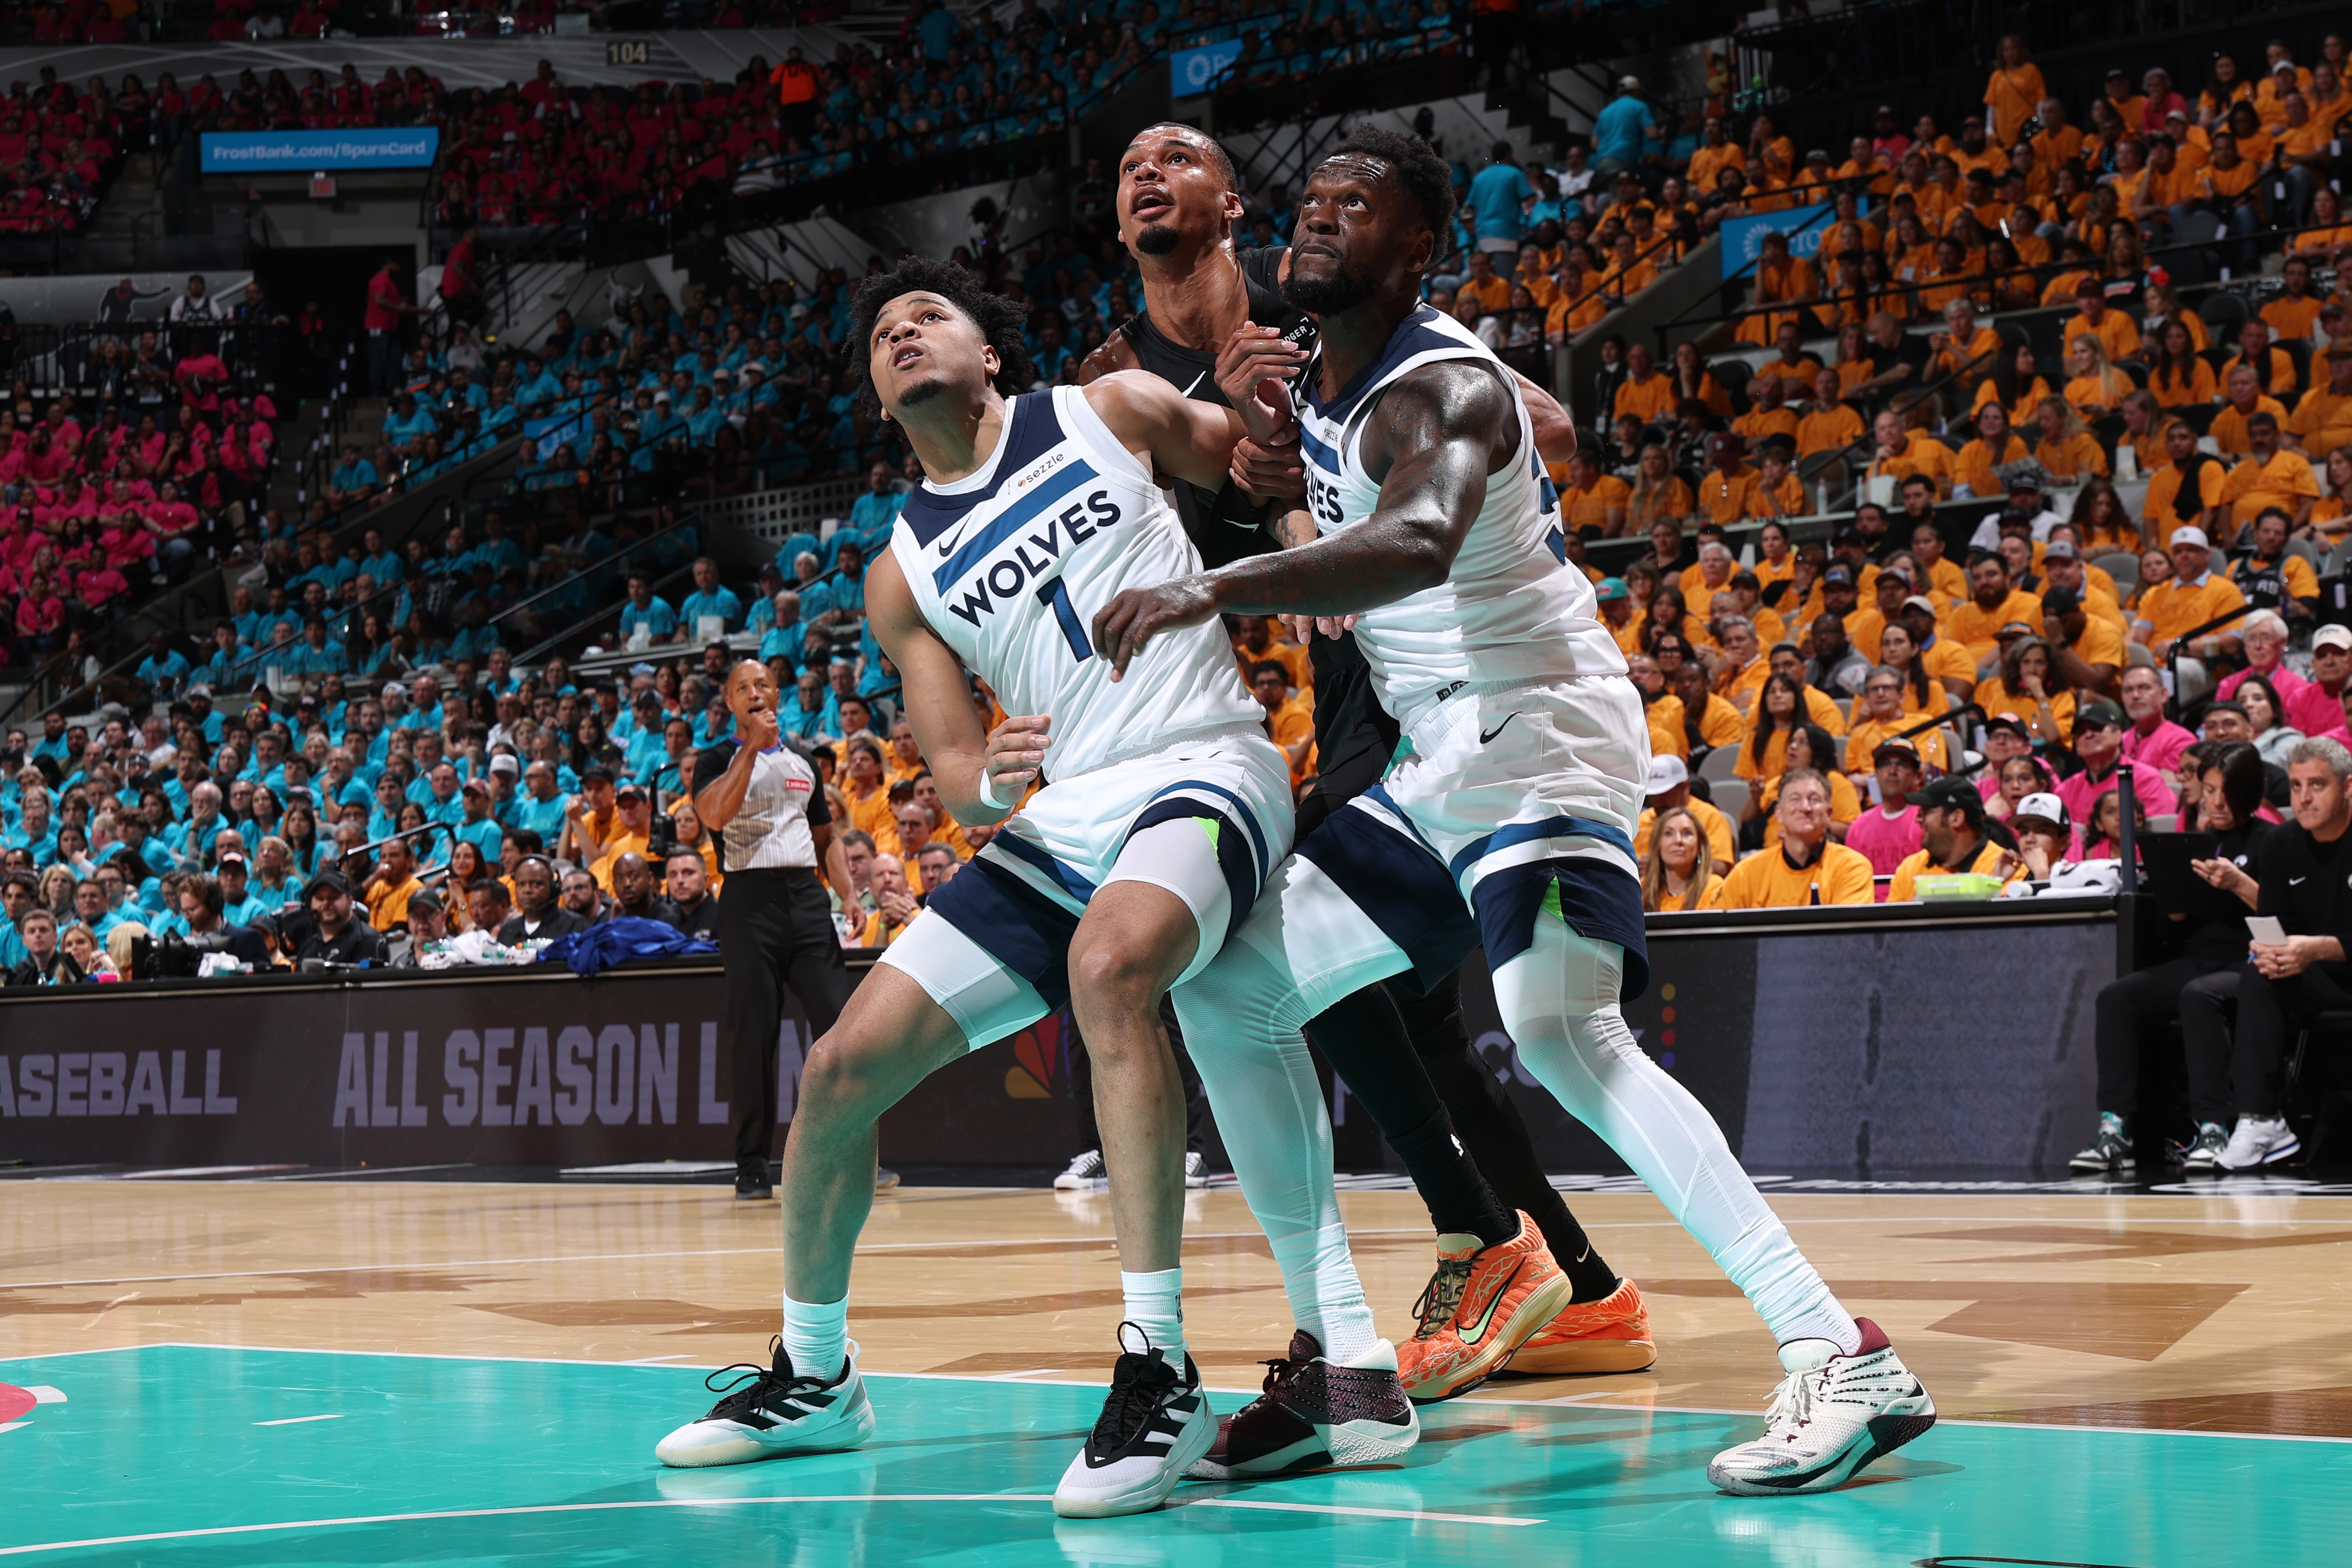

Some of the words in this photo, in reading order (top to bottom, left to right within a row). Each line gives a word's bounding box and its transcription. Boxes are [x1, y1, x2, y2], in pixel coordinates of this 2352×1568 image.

[608, 41, 647, 63] 104
[213, 140, 426, 160] FrostBank.com/SpursCard
[314, 180, 332, 194] EXIT
[1026, 454, 1064, 483] sezzle
[949, 491, 1121, 628] WOLVES
[1035, 575, 1094, 663] 1
[332, 1031, 427, 1127] ALL
[443, 1023, 679, 1126] SEASON
[698, 1019, 814, 1124] LN
[1278, 1402, 1306, 1419] SKECHERS
